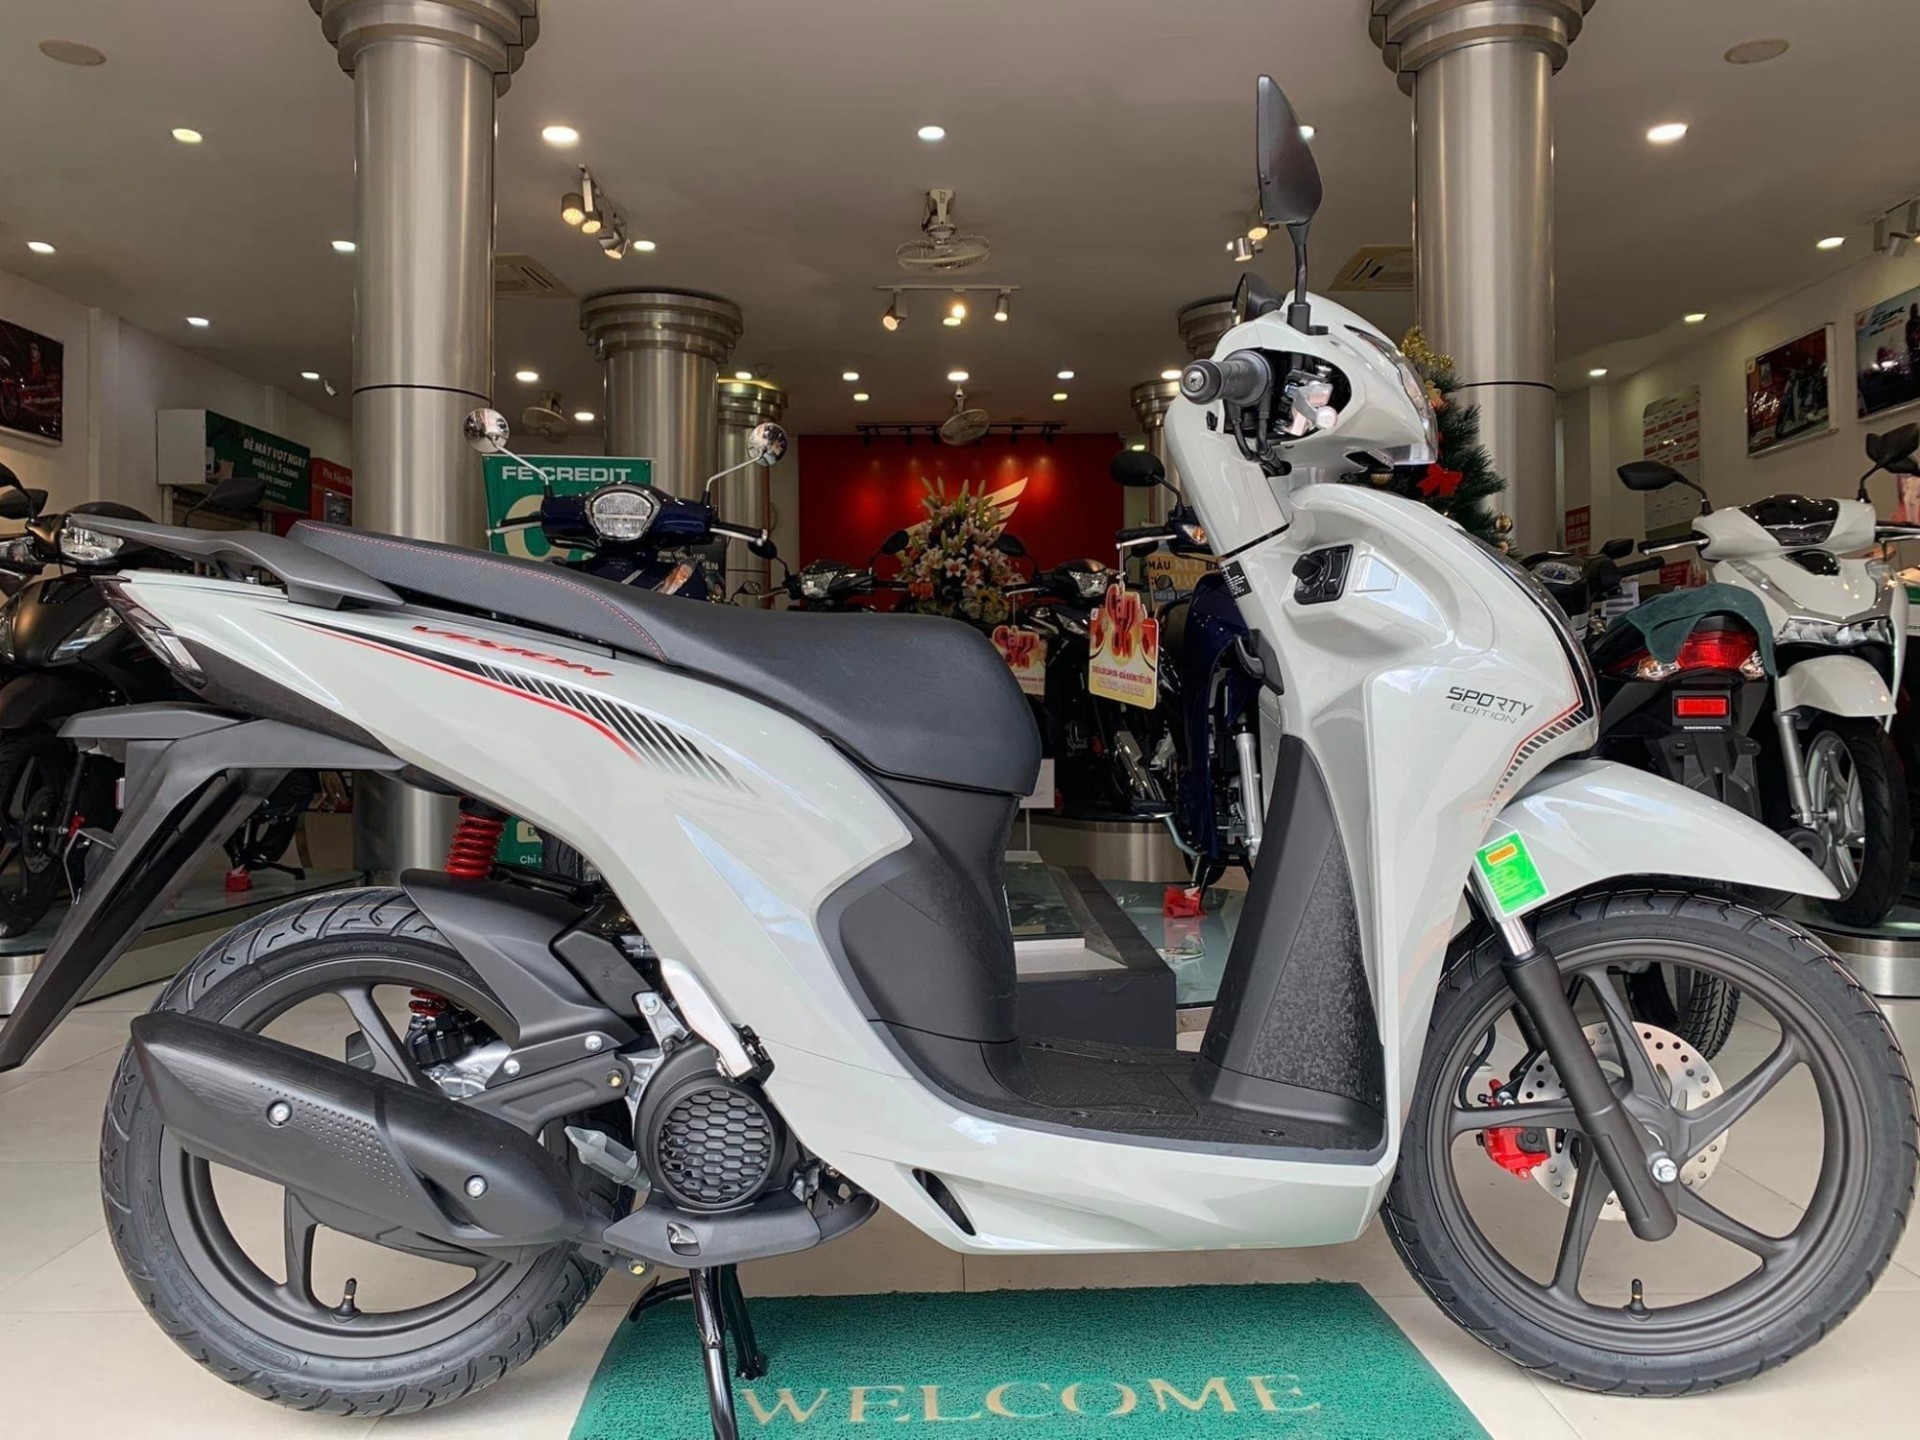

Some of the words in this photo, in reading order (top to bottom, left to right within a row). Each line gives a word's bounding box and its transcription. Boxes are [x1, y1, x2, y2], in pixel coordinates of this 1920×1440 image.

[502, 466, 534, 480] FE
[537, 467, 631, 482] CREDIT
[1148, 558, 1171, 570] MÀU
[411, 625, 616, 677] VISION
[1446, 686, 1534, 716] SPORTY
[1450, 703, 1517, 724] EDITION
[741, 1374, 1320, 1425] WELCOME
